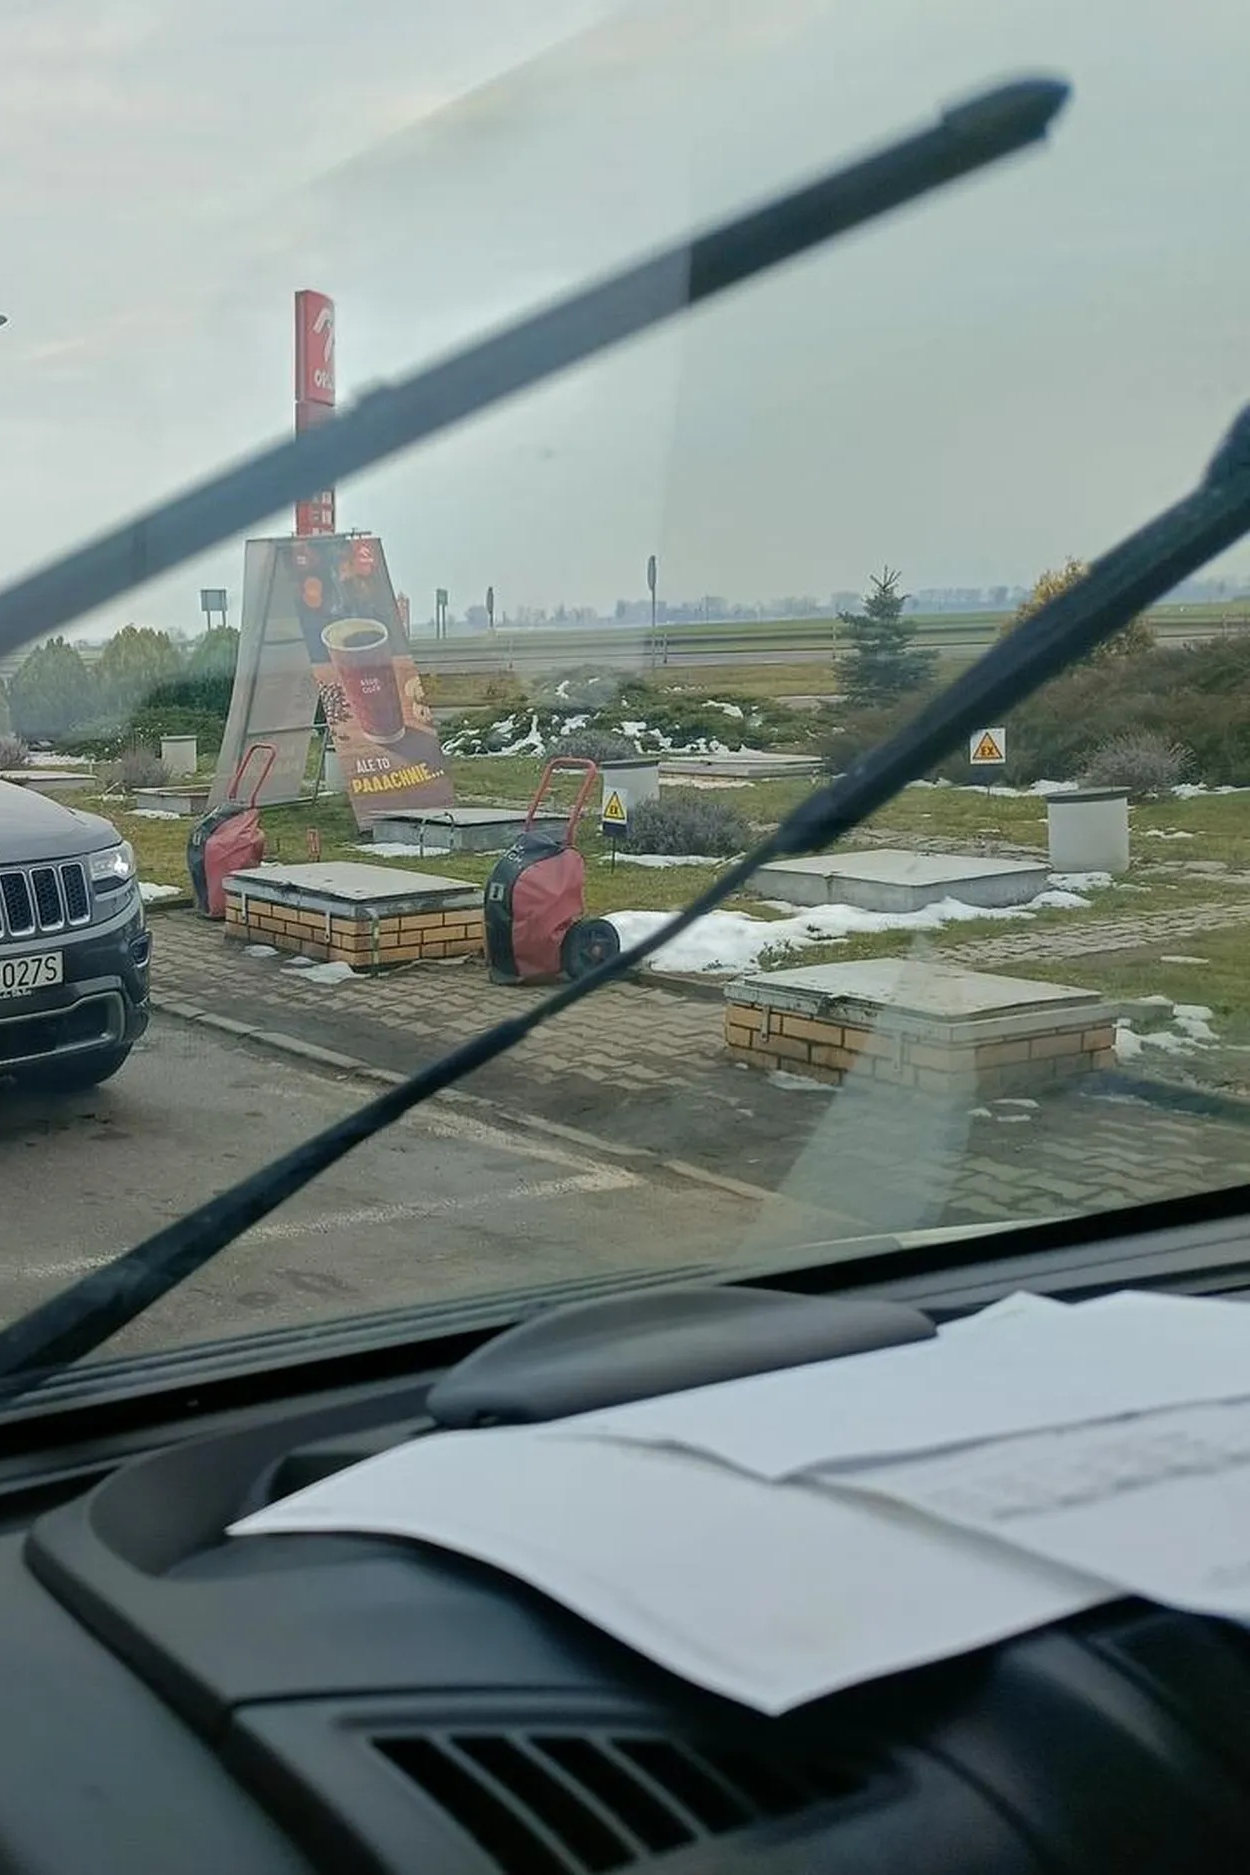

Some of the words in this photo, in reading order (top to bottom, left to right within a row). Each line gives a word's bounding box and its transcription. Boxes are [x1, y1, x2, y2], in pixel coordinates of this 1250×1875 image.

[980, 746, 994, 756] EX
[356, 758, 376, 774] ALE
[376, 757, 391, 770] TO
[352, 762, 445, 793] PAAACHNIE...
